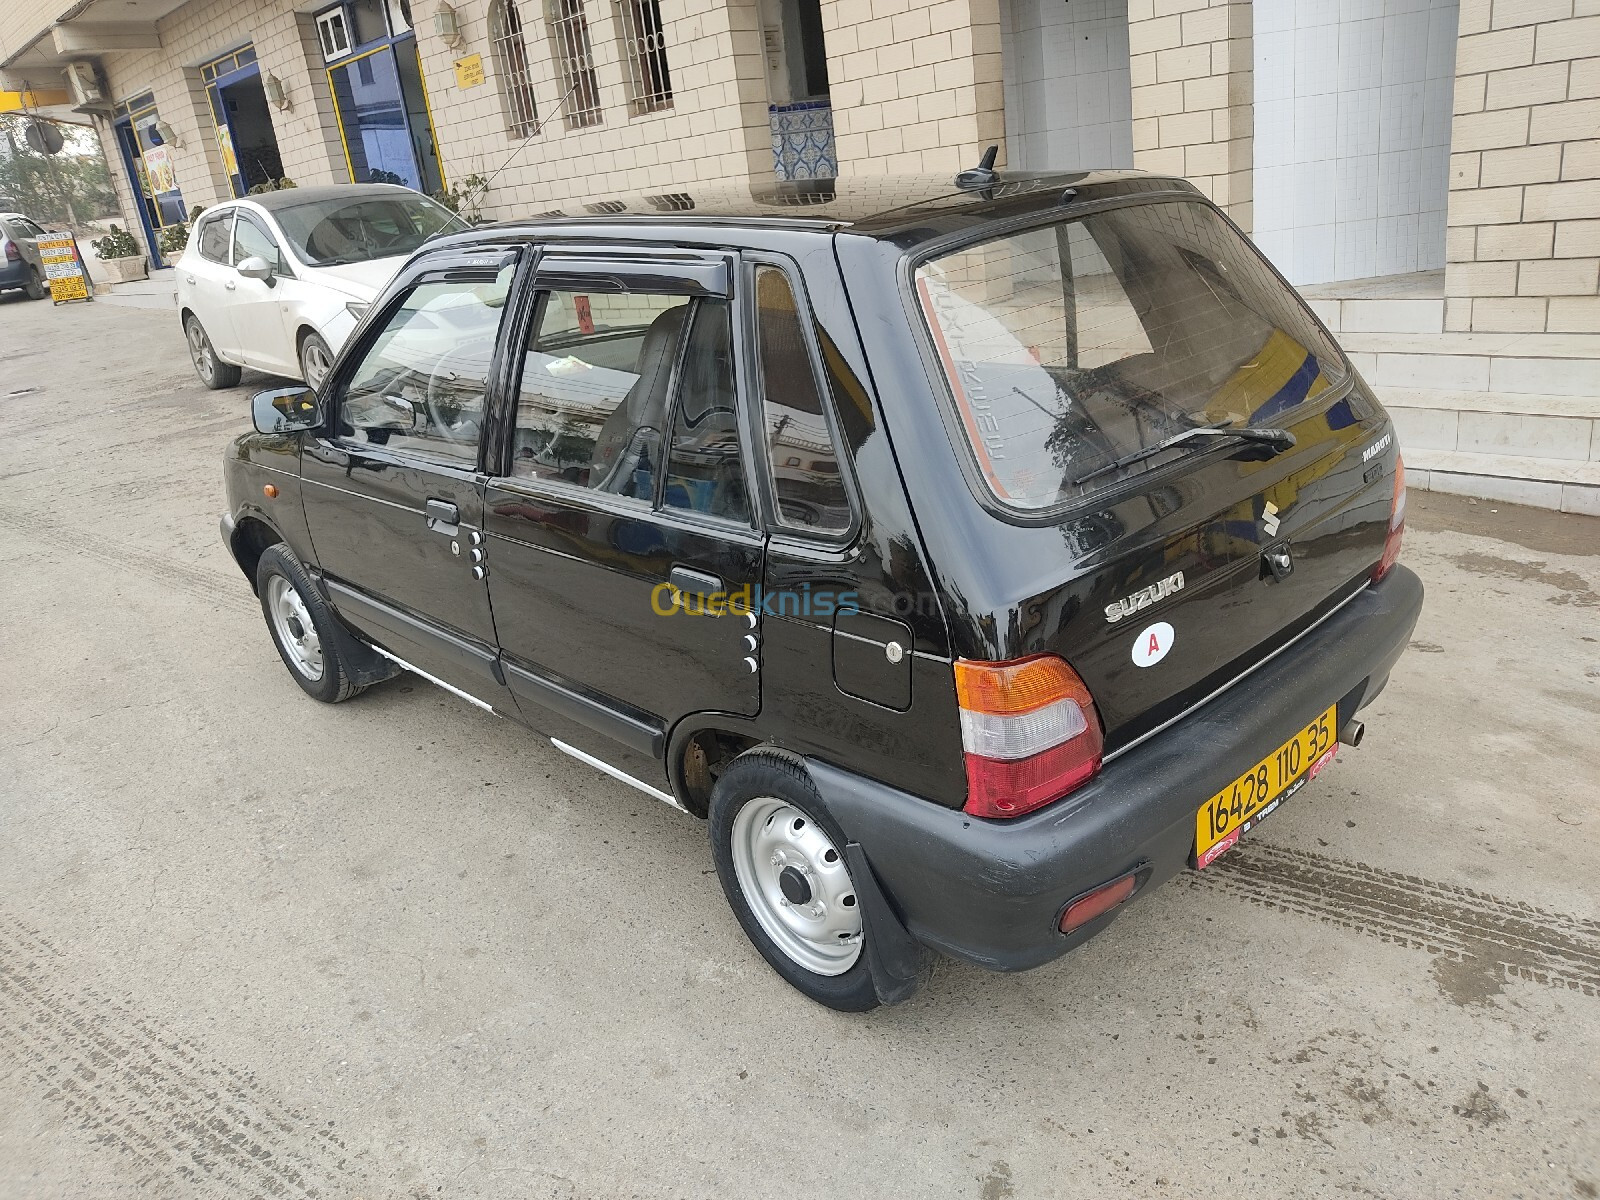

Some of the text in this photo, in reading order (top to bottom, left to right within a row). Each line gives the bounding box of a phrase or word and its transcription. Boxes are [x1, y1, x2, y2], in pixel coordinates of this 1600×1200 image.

[1362, 433, 1391, 463] MARUTI
[1104, 570, 1185, 623] SUZUKI
[1147, 633, 1160, 657] A
[1207, 712, 1329, 841] 16428 110 35
